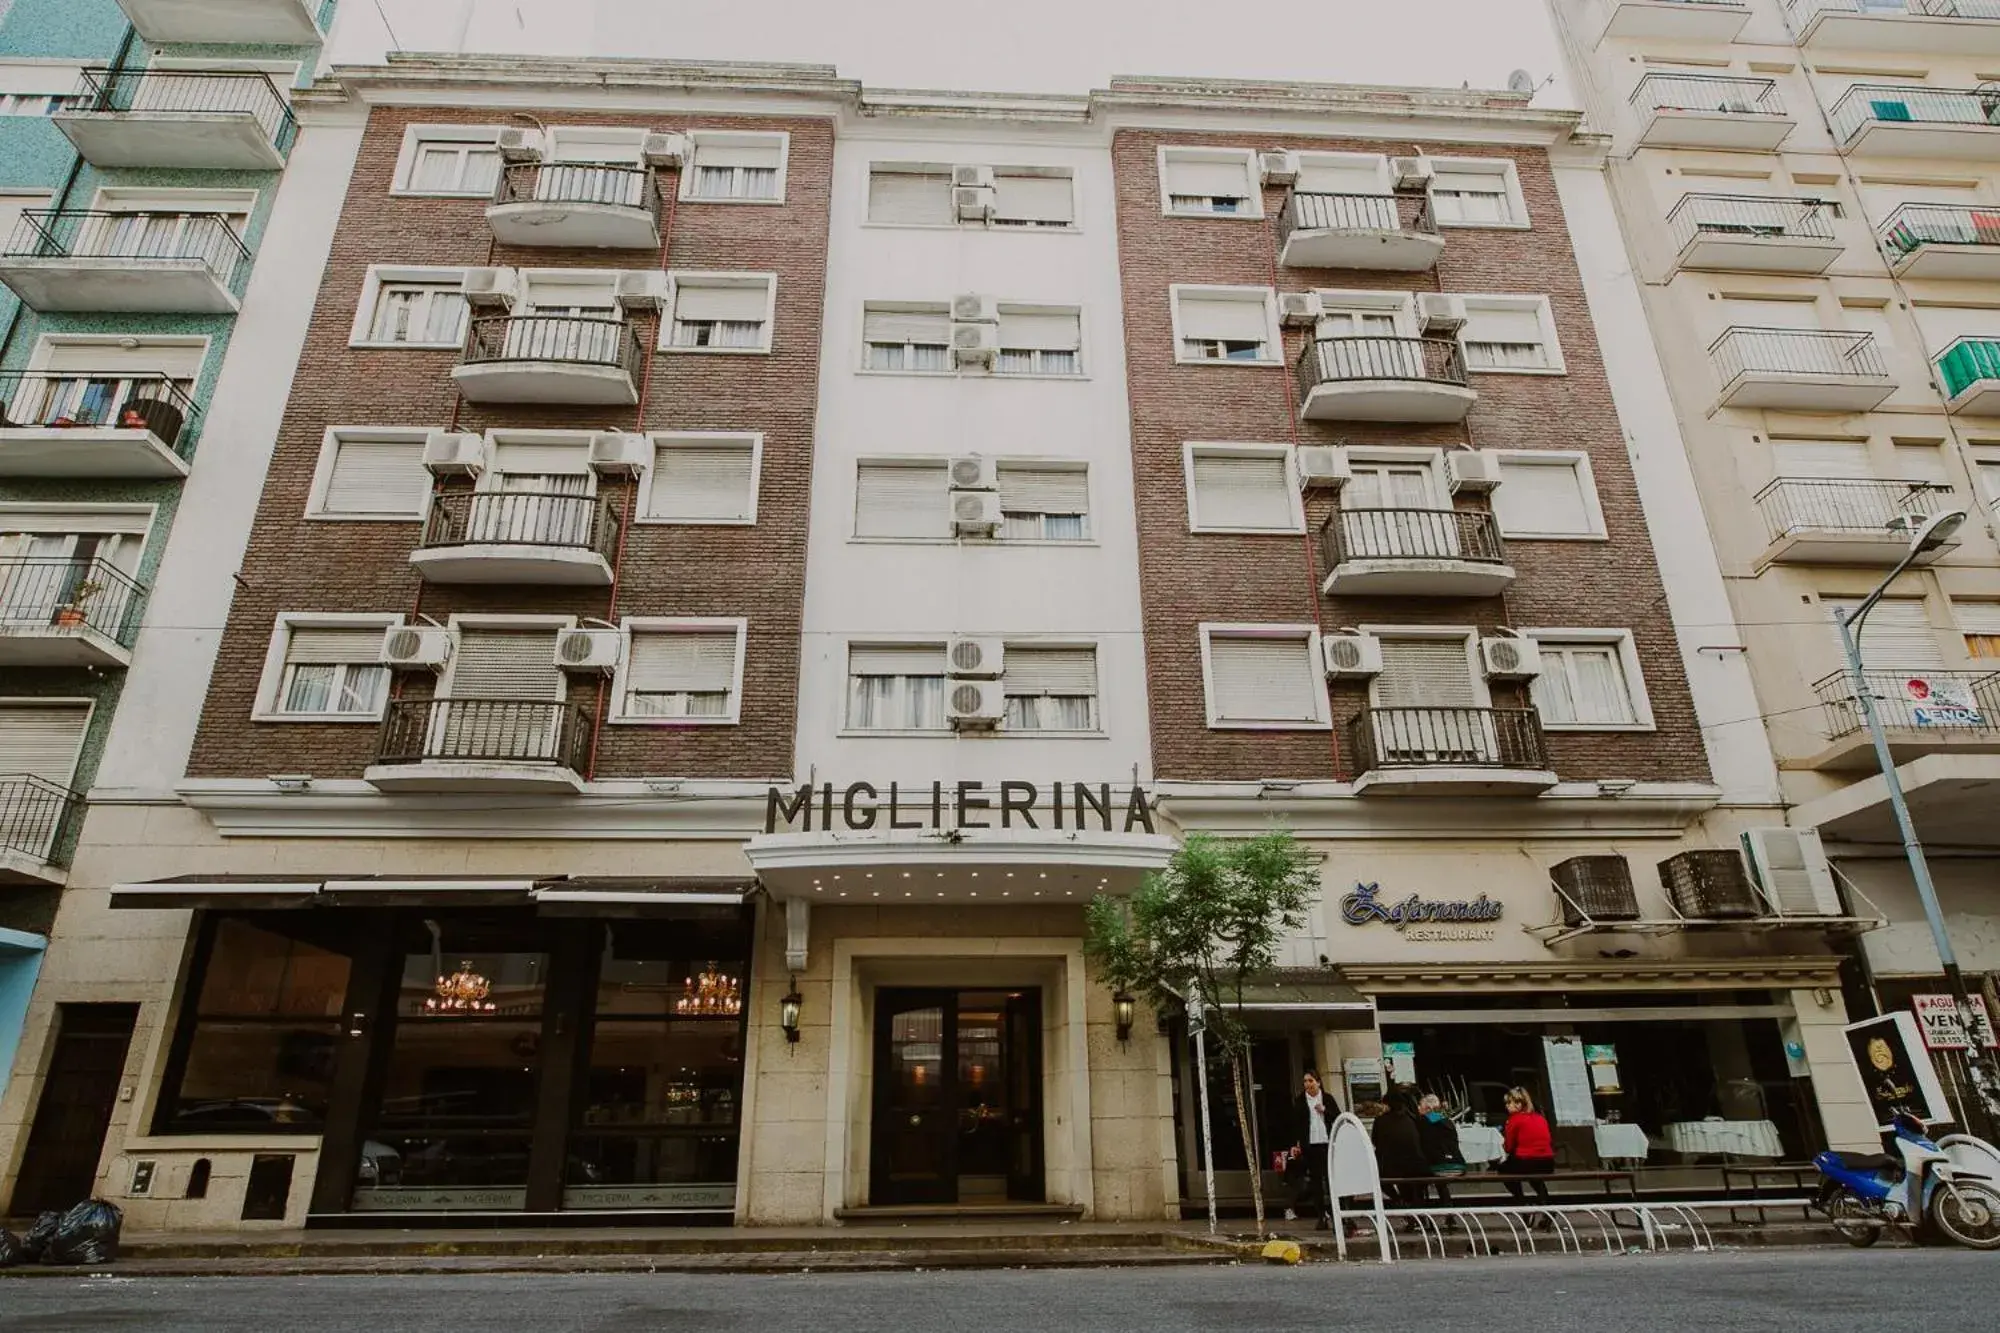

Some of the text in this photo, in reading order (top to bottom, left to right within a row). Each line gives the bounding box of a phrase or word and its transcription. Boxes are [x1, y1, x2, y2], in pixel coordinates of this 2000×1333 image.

[766, 780, 1156, 834] MIGLIERINA
[1405, 927, 1496, 942] RESTAURANT
[1923, 1015, 1986, 1026] VENE
